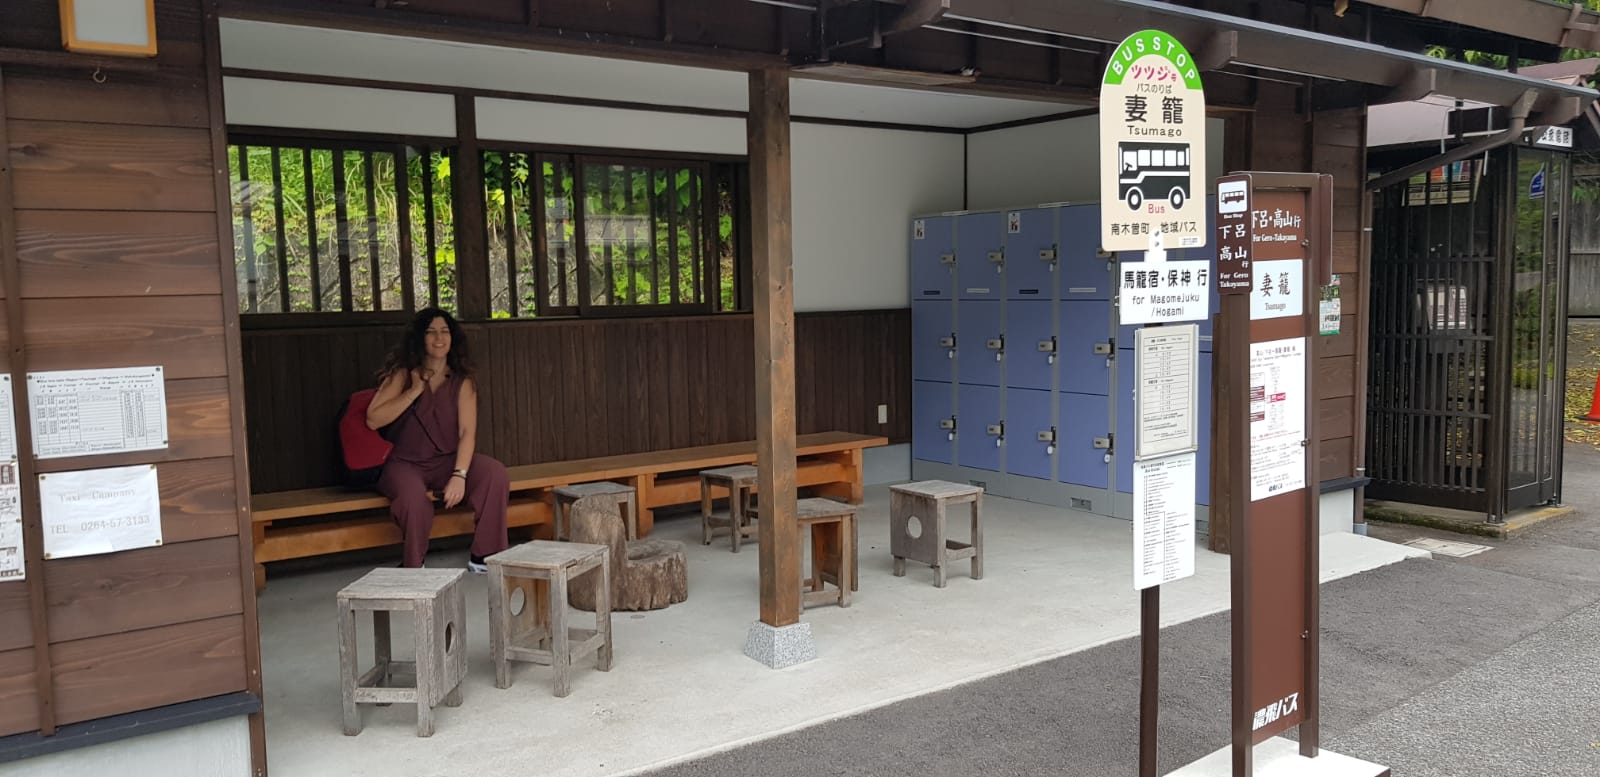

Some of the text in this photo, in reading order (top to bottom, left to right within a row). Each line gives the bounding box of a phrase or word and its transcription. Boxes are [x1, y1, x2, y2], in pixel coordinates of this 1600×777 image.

[1112, 36, 1195, 79] BUS STOP
[1136, 83, 1173, 94] バスのりば
[1124, 94, 1184, 125] 妻籠
[1127, 125, 1183, 138] Tsumago
[1148, 203, 1165, 214] Bus
[1218, 223, 1246, 239] 下呂
[1219, 245, 1247, 261] 高山
[1241, 260, 1249, 268] 行
[1233, 271, 1249, 279] Gero
[1219, 280, 1249, 288] Takayama
[1260, 271, 1290, 297] 妻籠
[1132, 293, 1200, 306] for Magomejuku
[1151, 305, 1185, 318] /Hogami
[1264, 302, 1286, 311] Tsumago
[59, 487, 136, 504] Taxi Company
[50, 514, 151, 535] TEL 0264-57-3133
